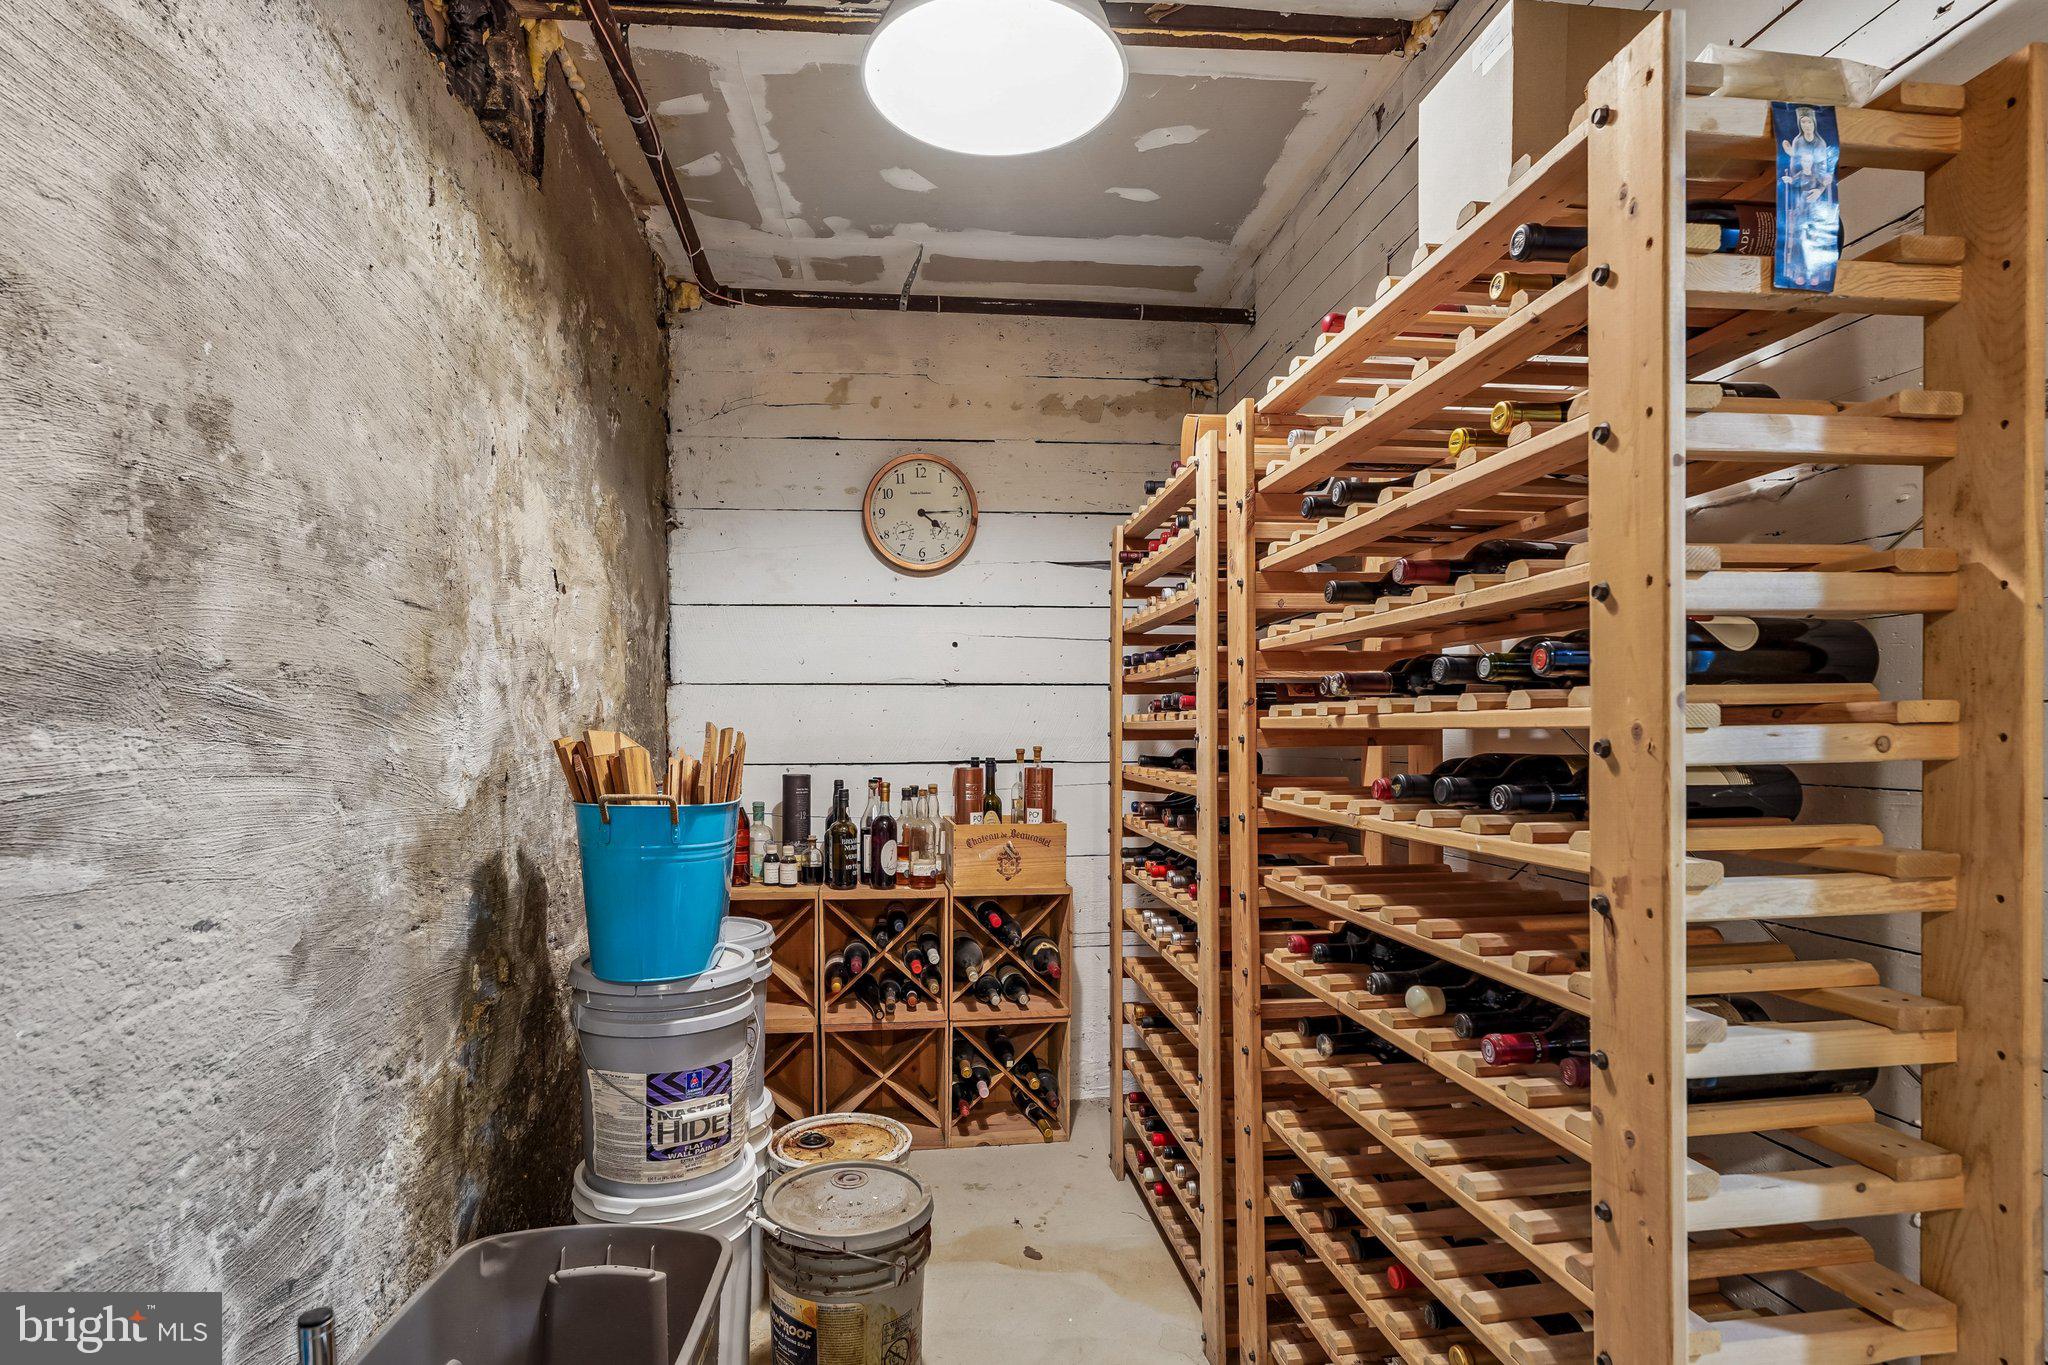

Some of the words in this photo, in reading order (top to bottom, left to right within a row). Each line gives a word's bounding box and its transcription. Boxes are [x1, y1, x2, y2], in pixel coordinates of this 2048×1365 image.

[915, 467, 927, 479] 12
[938, 473, 943, 483] 1
[895, 473, 905, 485] 11
[882, 488, 893, 499] 10
[952, 487, 959, 497] 2
[878, 509, 886, 519] 9
[956, 507, 964, 517] 3
[883, 531, 890, 540] 8
[953, 529, 960, 538] 4
[899, 543, 906, 553] 7
[918, 547, 926, 558] 6
[940, 543, 946, 553] 5
[1009, 829, 1052, 848] Beaucastel
[657, 1099, 725, 1121] MASTER
[657, 1114, 725, 1145] HIDE
[667, 1150, 694, 1160] WALL
[694, 1143, 718, 1155] PAINT
[684, 1141, 705, 1152] FLAT
